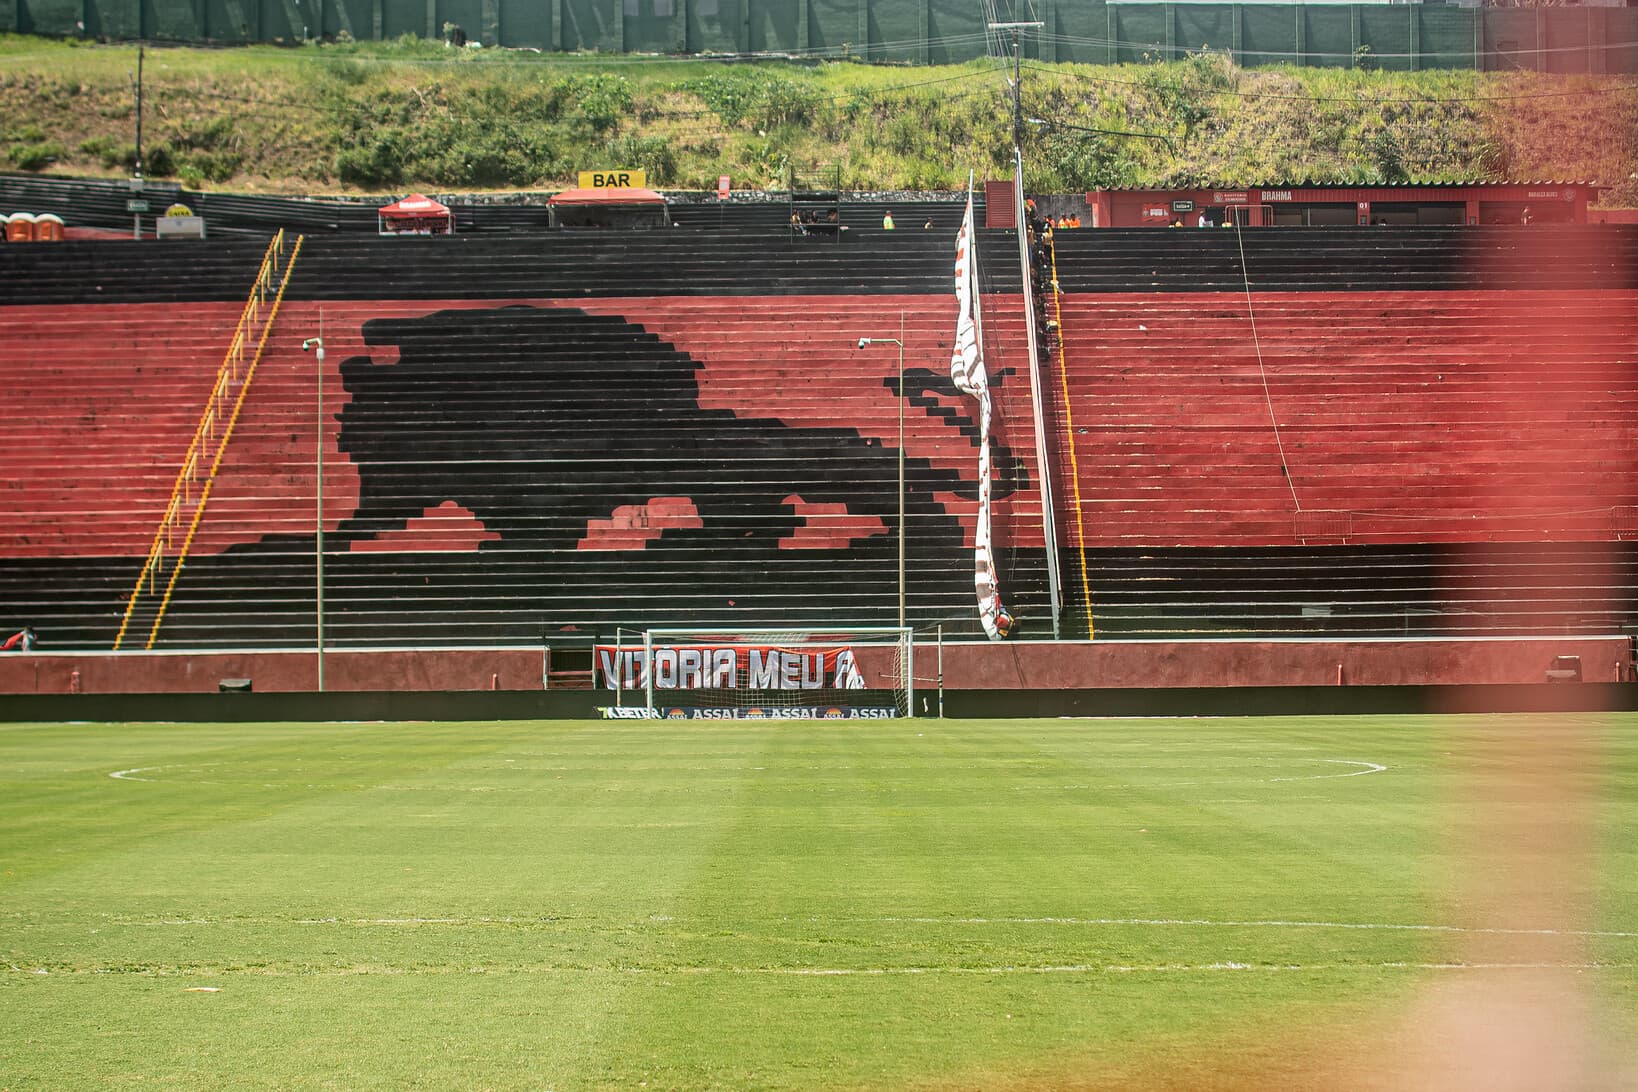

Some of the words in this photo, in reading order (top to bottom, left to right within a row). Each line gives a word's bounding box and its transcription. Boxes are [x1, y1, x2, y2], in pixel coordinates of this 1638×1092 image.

[593, 173, 630, 187] BAR
[1261, 191, 1292, 201] BRAHMA
[749, 649, 824, 690] MEU
